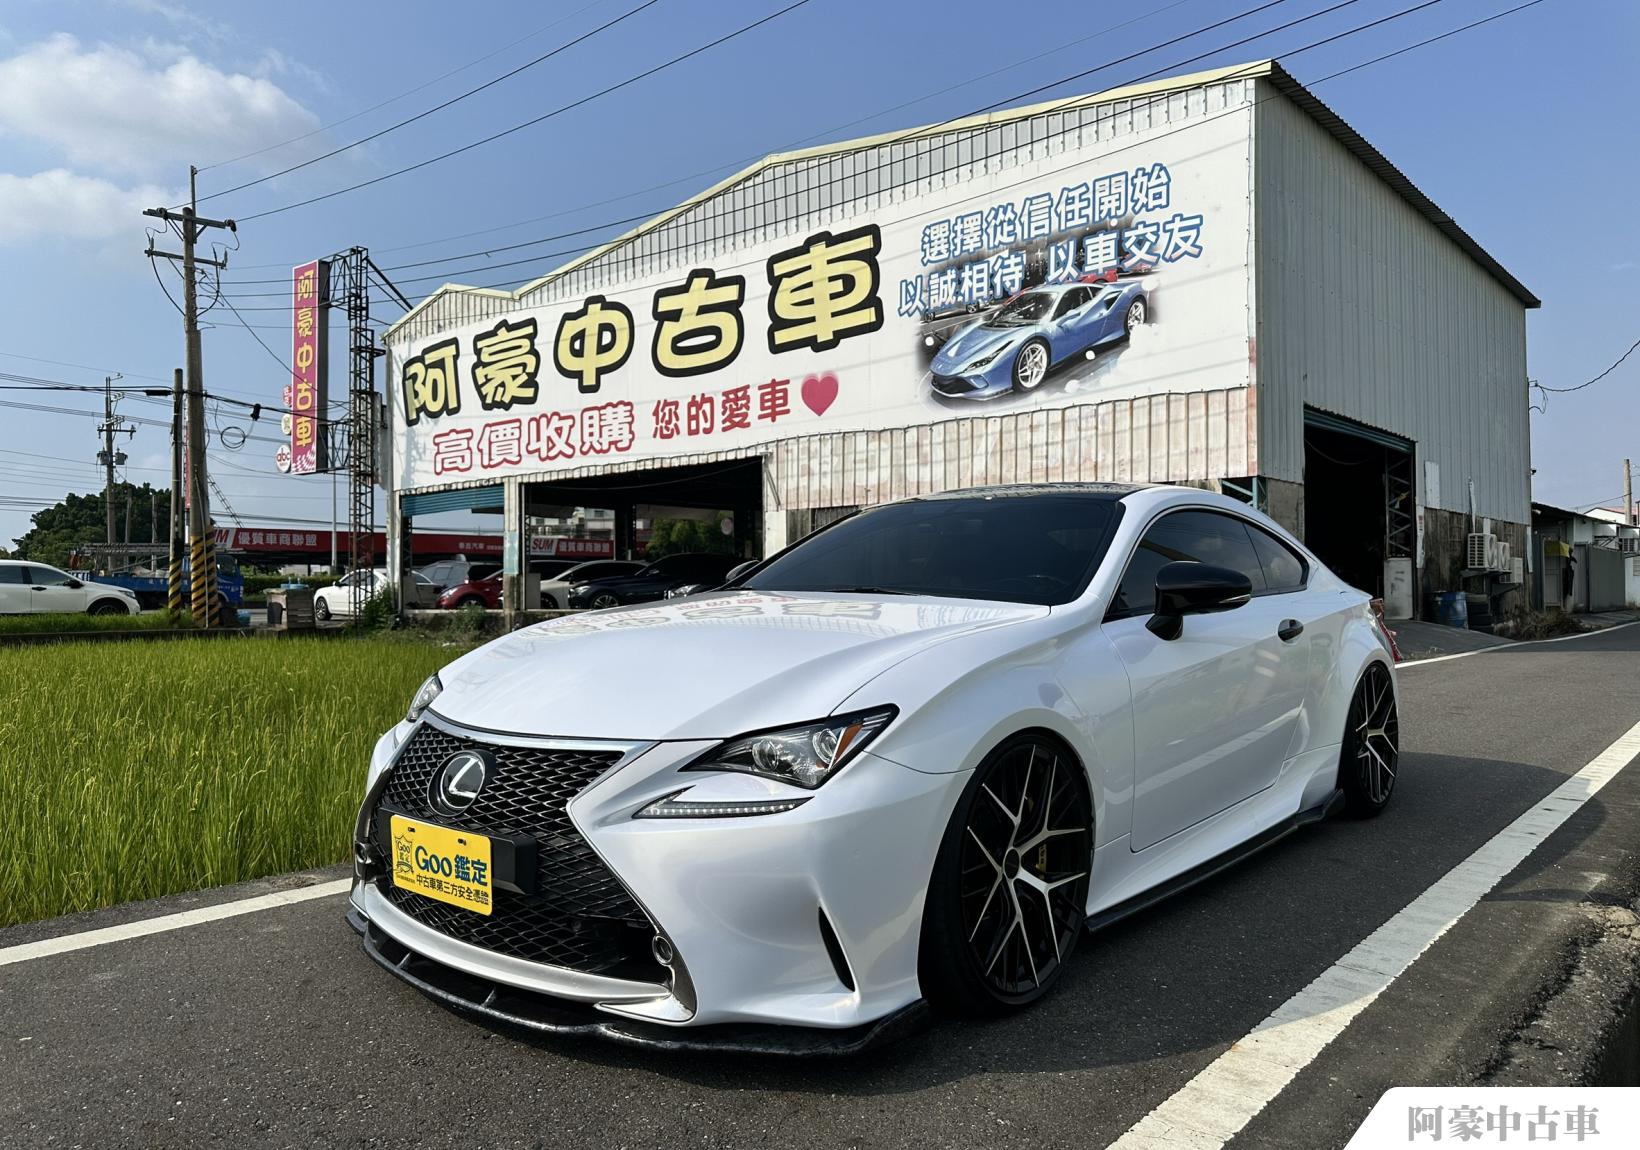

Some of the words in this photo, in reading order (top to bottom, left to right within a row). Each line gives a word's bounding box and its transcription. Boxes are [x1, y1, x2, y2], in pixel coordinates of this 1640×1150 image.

[920, 162, 1172, 266] 選擇從信任開始
[897, 248, 1027, 317] 以誠相待
[1046, 212, 1204, 284] 以車交友
[296, 269, 314, 447] 阿豪中古車
[402, 223, 882, 426] 阿豪中古車
[433, 400, 637, 476] 高價收購
[652, 378, 792, 440] 您的愛車
[238, 531, 317, 546] 優質車商聯盟
[531, 538, 554, 550] SUM
[415, 845, 452, 878] Goo
[454, 854, 488, 887] 鑑定
[416, 873, 489, 906] 中古車第三方安全憑證
